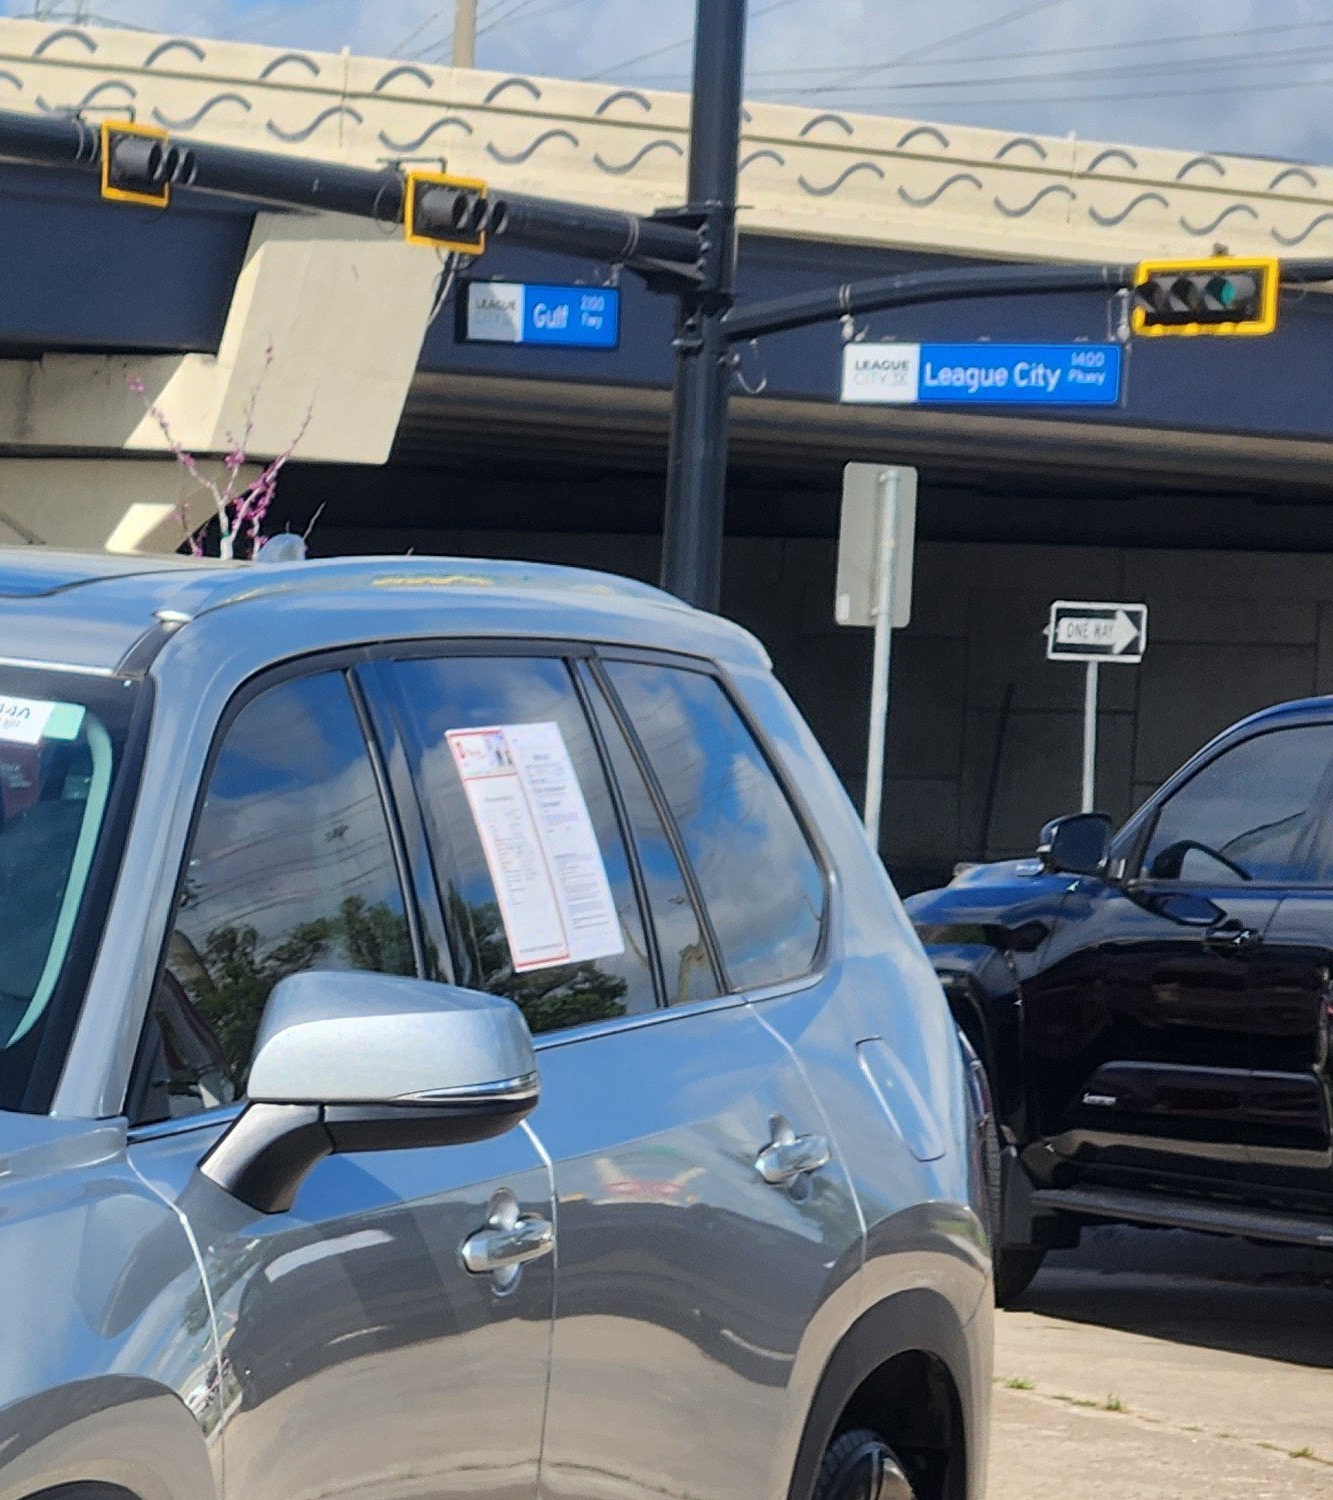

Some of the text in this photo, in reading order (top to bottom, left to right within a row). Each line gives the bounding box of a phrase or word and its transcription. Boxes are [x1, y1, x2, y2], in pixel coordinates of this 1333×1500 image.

[534, 302, 570, 329] Gulf
[855, 359, 910, 371] LEAGUE
[923, 361, 1062, 394] League City
[1067, 622, 1114, 639] ONE WAY
